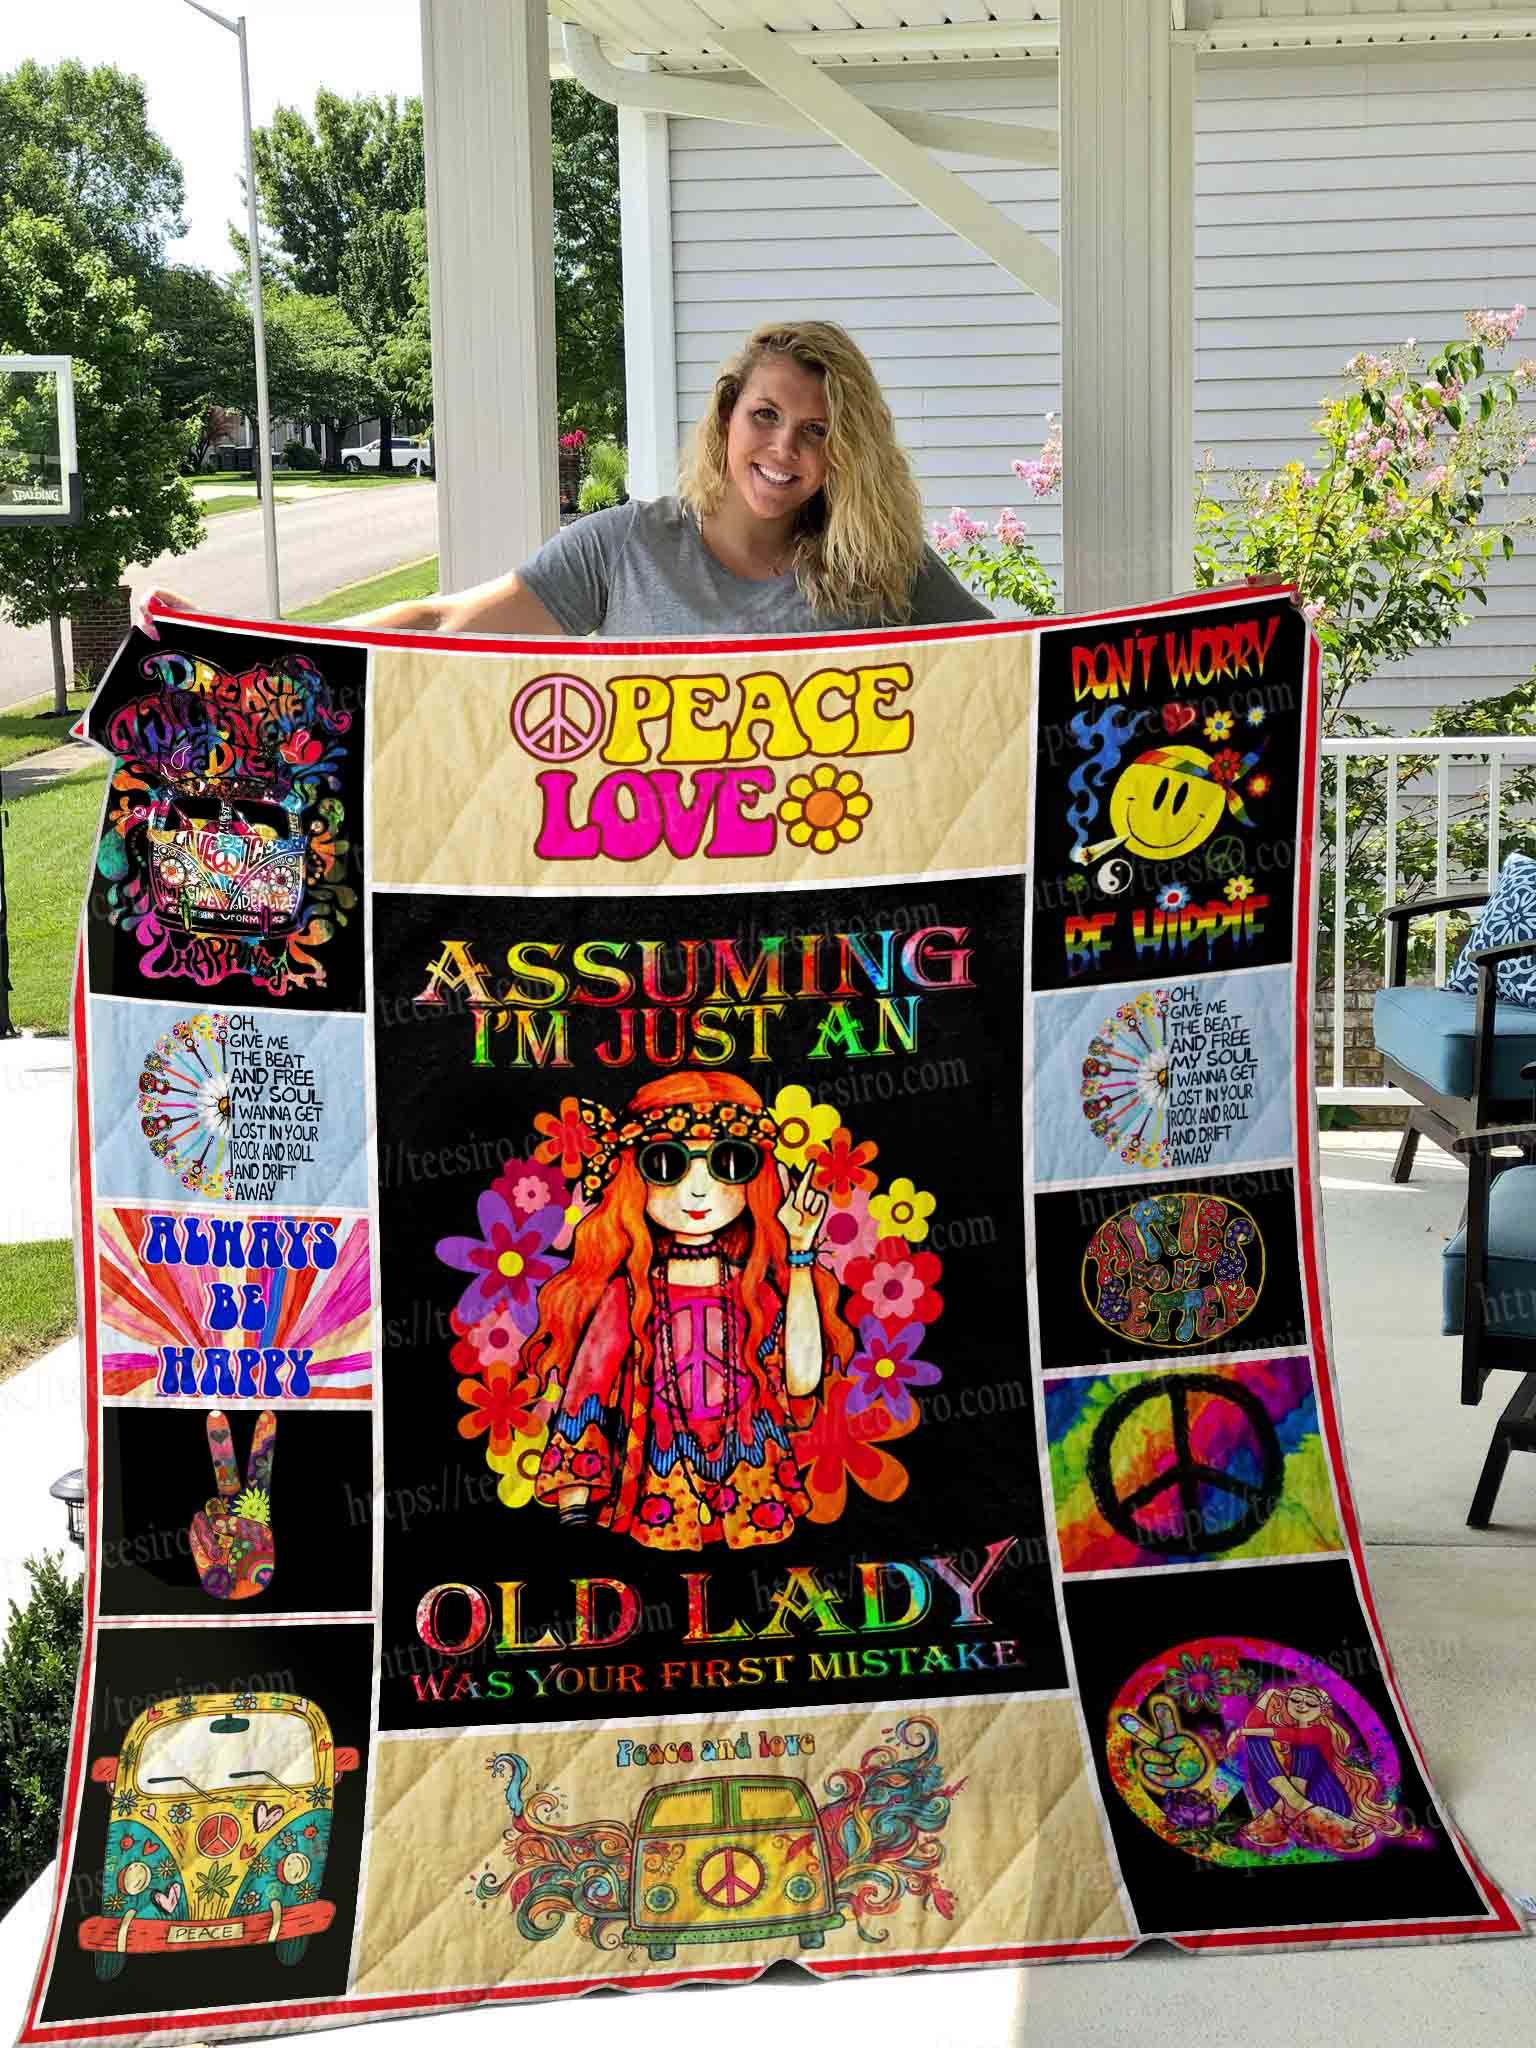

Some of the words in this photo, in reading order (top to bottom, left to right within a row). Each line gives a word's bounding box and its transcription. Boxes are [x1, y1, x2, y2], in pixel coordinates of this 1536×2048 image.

[12, 489, 59, 501] SPALDING
[1072, 629, 1157, 702] DON'T
[1165, 616, 1280, 688] WORRY
[601, 662, 914, 765] PEACE
[534, 766, 776, 862] LOVE
[411, 926, 978, 1007] ASSUMING
[1171, 1003, 1202, 1019] GIVE
[1206, 1000, 1227, 1014] ME
[471, 1007, 574, 1068] I'M
[595, 1004, 786, 1066] JUST
[807, 995, 923, 1060] AN
[1171, 1020, 1201, 1036] THE
[1204, 1015, 1243, 1033] BEAT
[230, 1034, 264, 1049] GIVE
[267, 1036, 289, 1050] ME
[1170, 1036, 1207, 1054] AND
[1212, 1029, 1251, 1047] FREE
[230, 1051, 262, 1067] THE
[266, 1052, 305, 1069] BEAT
[1171, 1053, 1201, 1071] MY
[1207, 1047, 1258, 1067] SOUL
[231, 1068, 269, 1085] AND
[273, 1070, 314, 1086] FREE
[1177, 1069, 1225, 1086] WANNA
[1231, 1064, 1258, 1081] GET
[232, 1086, 264, 1101] MY
[270, 1086, 324, 1105] SOUL
[1170, 1090, 1202, 1107] LOST
[1205, 1087, 1218, 1102] IN
[1220, 1083, 1254, 1100] YOUR
[239, 1106, 292, 1121] WANNA
[295, 1107, 323, 1122] GET
[1171, 1108, 1197, 1126] ROCK
[1200, 1105, 1221, 1123] AND
[1223, 1103, 1249, 1120] ROLL
[232, 1123, 266, 1140] LOST
[270, 1124, 282, 1140] IN
[284, 1125, 319, 1142] YOUR
[1171, 1128, 1196, 1146] AND
[1199, 1125, 1232, 1143] DRIFT
[233, 1142, 261, 1160] ROCK
[263, 1144, 286, 1161] AND
[288, 1144, 314, 1162] ROLL
[1172, 1143, 1212, 1166] AWAY
[234, 1164, 259, 1180] AND
[263, 1165, 296, 1181] DRIFT
[235, 1181, 276, 1201] AWAY
[139, 1215, 338, 1270] ALWAYS
[205, 1282, 267, 1331] BE
[156, 1345, 314, 1399] HAPPY
[415, 1577, 643, 1657] OLD
[680, 1536, 1018, 1641] LADY
[410, 1667, 514, 1702] WAS
[526, 1662, 649, 1700] YOUR
[661, 1654, 795, 1688] FIRST
[808, 1639, 1028, 1683] MISTAKE
[616, 1735, 694, 1768] Peace
[700, 1731, 752, 1762] and
[758, 1731, 817, 1759] love
[175, 1926, 232, 1940] PEACE
